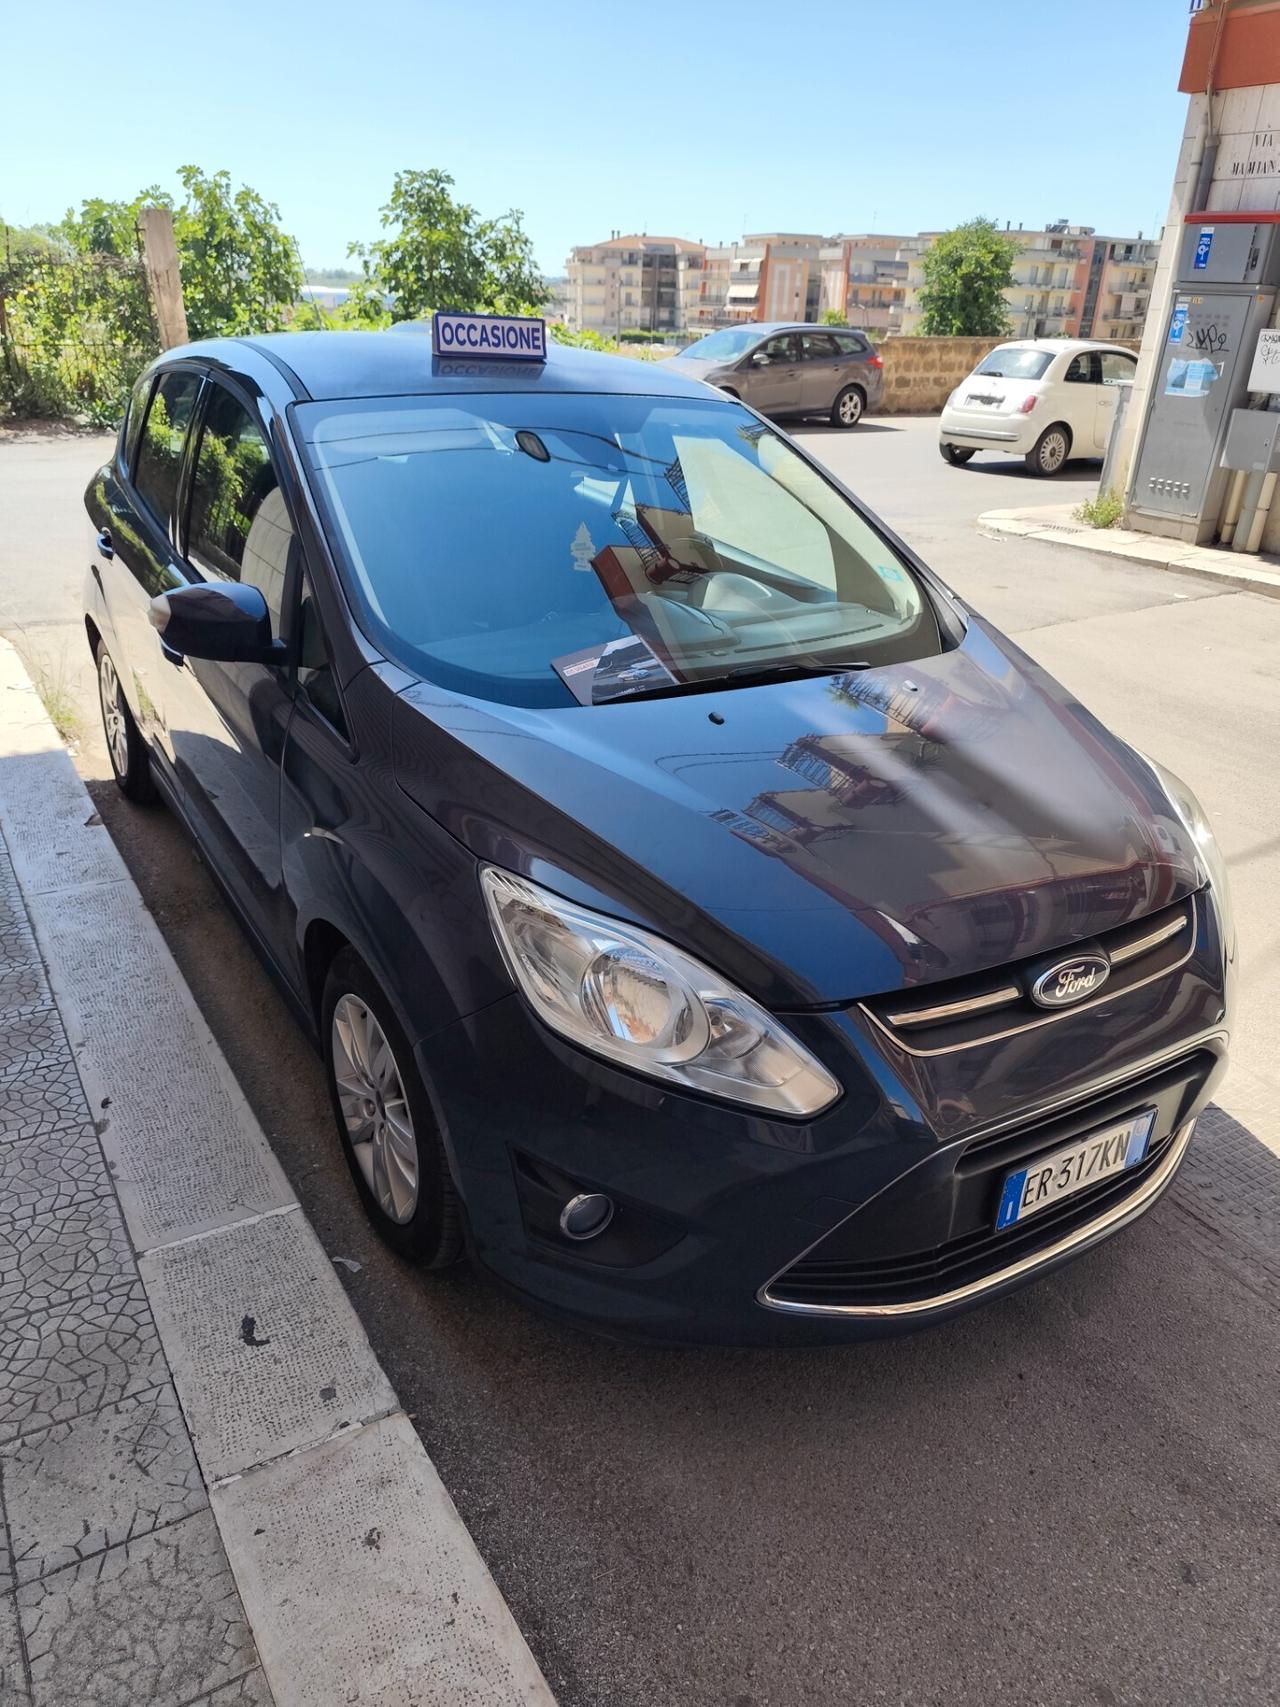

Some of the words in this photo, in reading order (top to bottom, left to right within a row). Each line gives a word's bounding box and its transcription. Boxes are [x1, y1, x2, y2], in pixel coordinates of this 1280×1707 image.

[1255, 133, 1273, 147] VIA
[1232, 160, 1280, 175] MAMIAN
[441, 322, 541, 350] OCCASIONE
[1055, 965, 1096, 998] Ford
